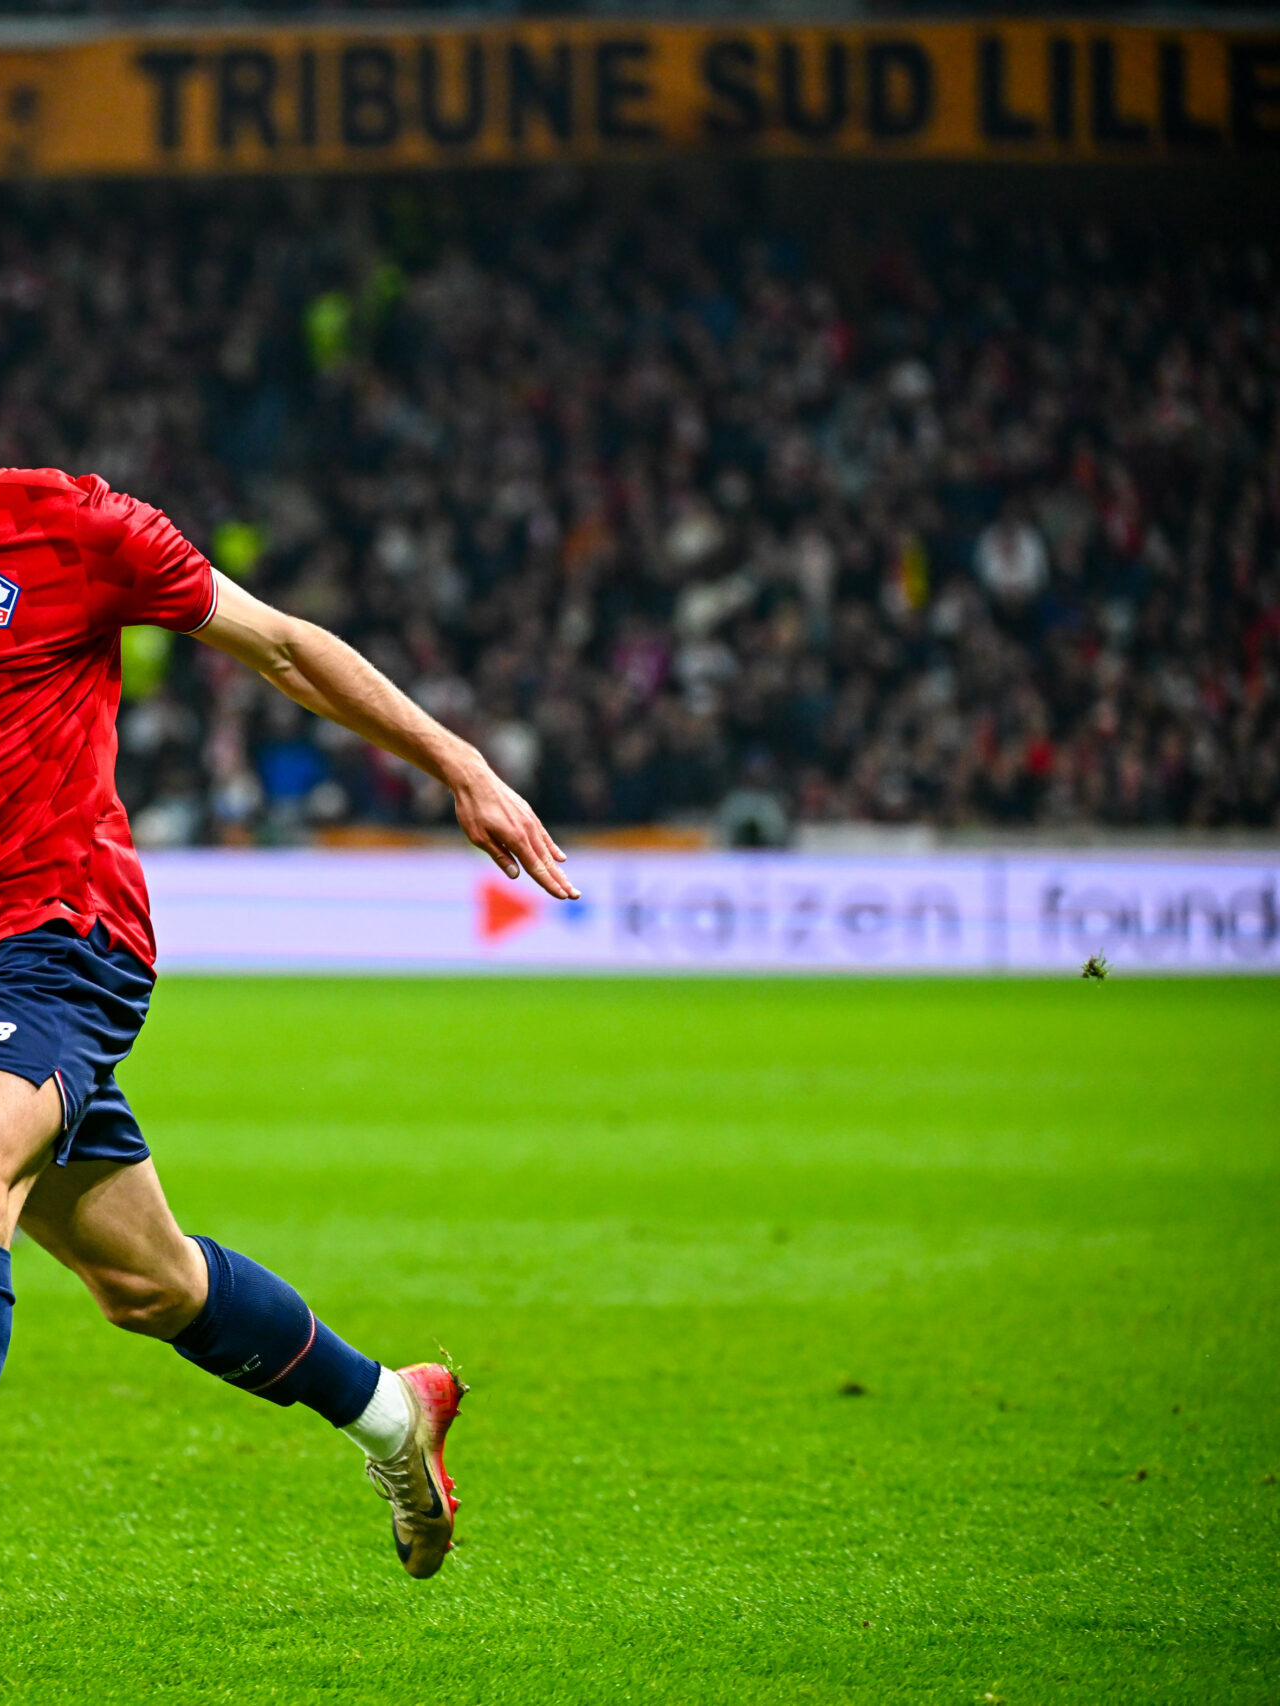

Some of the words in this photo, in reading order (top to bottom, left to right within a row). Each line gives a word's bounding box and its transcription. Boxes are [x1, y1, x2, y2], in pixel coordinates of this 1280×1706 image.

[136, 38, 662, 150] TRIBUNE
[702, 36, 934, 142] SUD
[976, 34, 1280, 142] LILLE
